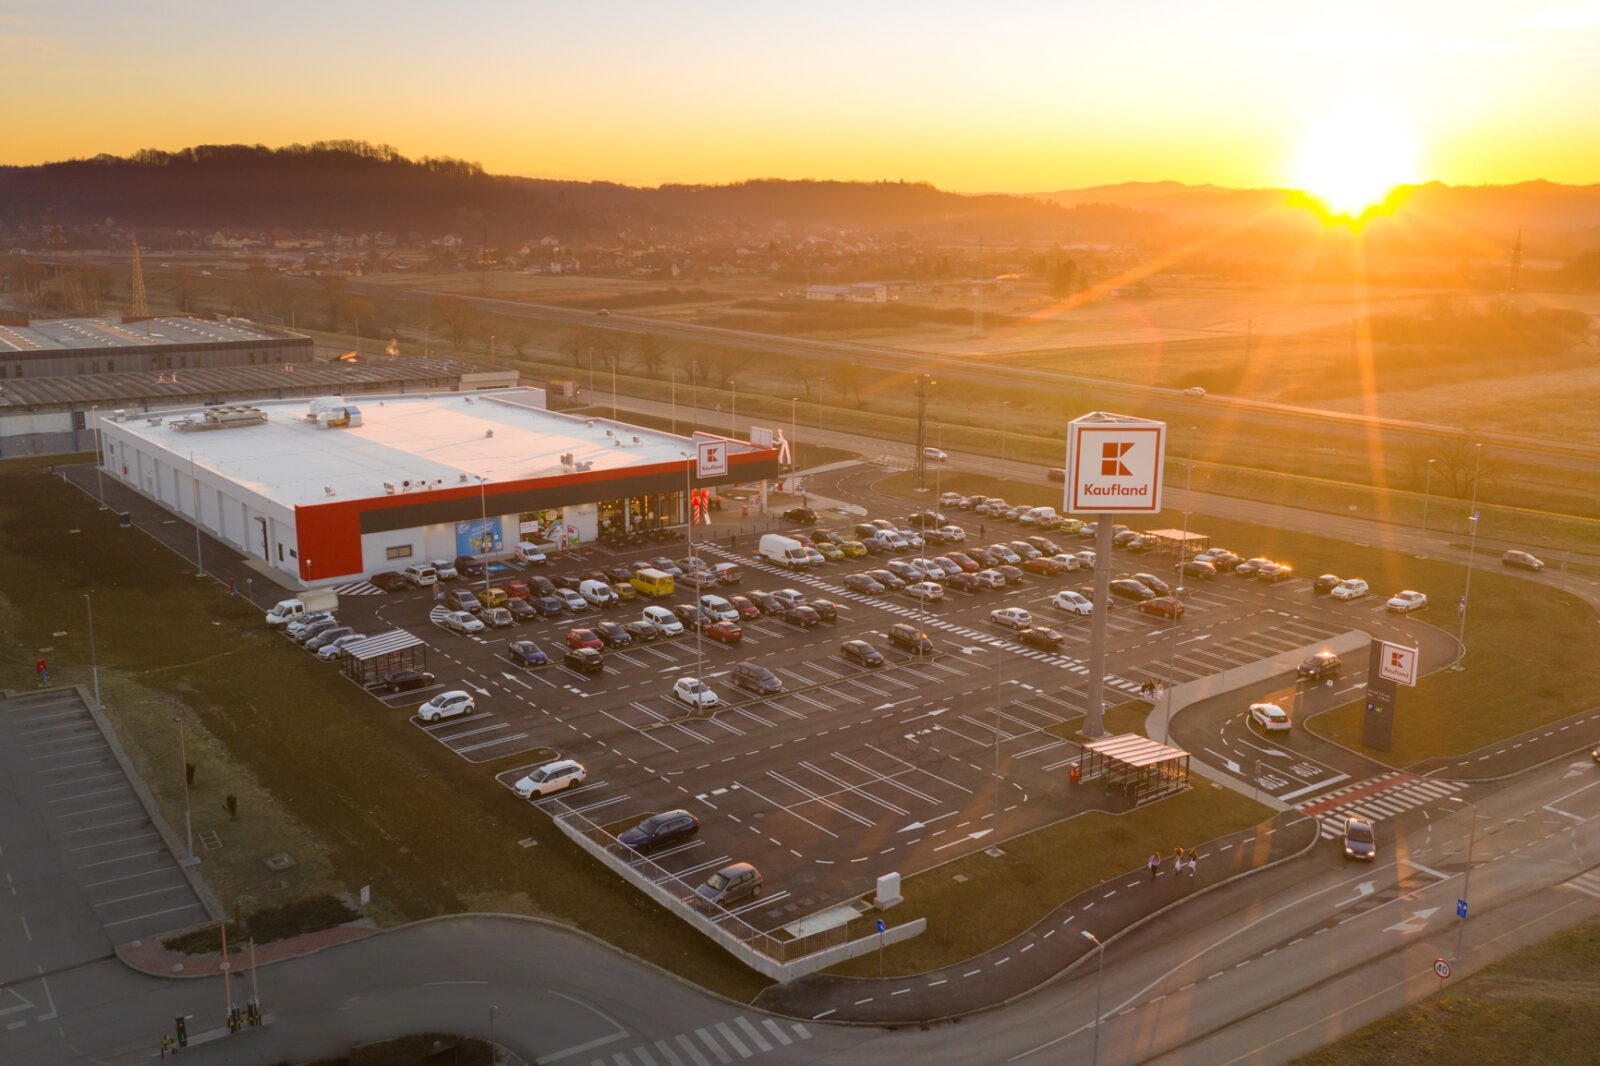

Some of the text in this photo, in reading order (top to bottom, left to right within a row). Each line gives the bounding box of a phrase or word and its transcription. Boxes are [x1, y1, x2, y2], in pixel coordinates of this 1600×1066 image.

[1084, 483, 1147, 496] Kaufland
[1384, 667, 1408, 678] Kaufland
[1437, 963, 1448, 976] 40
